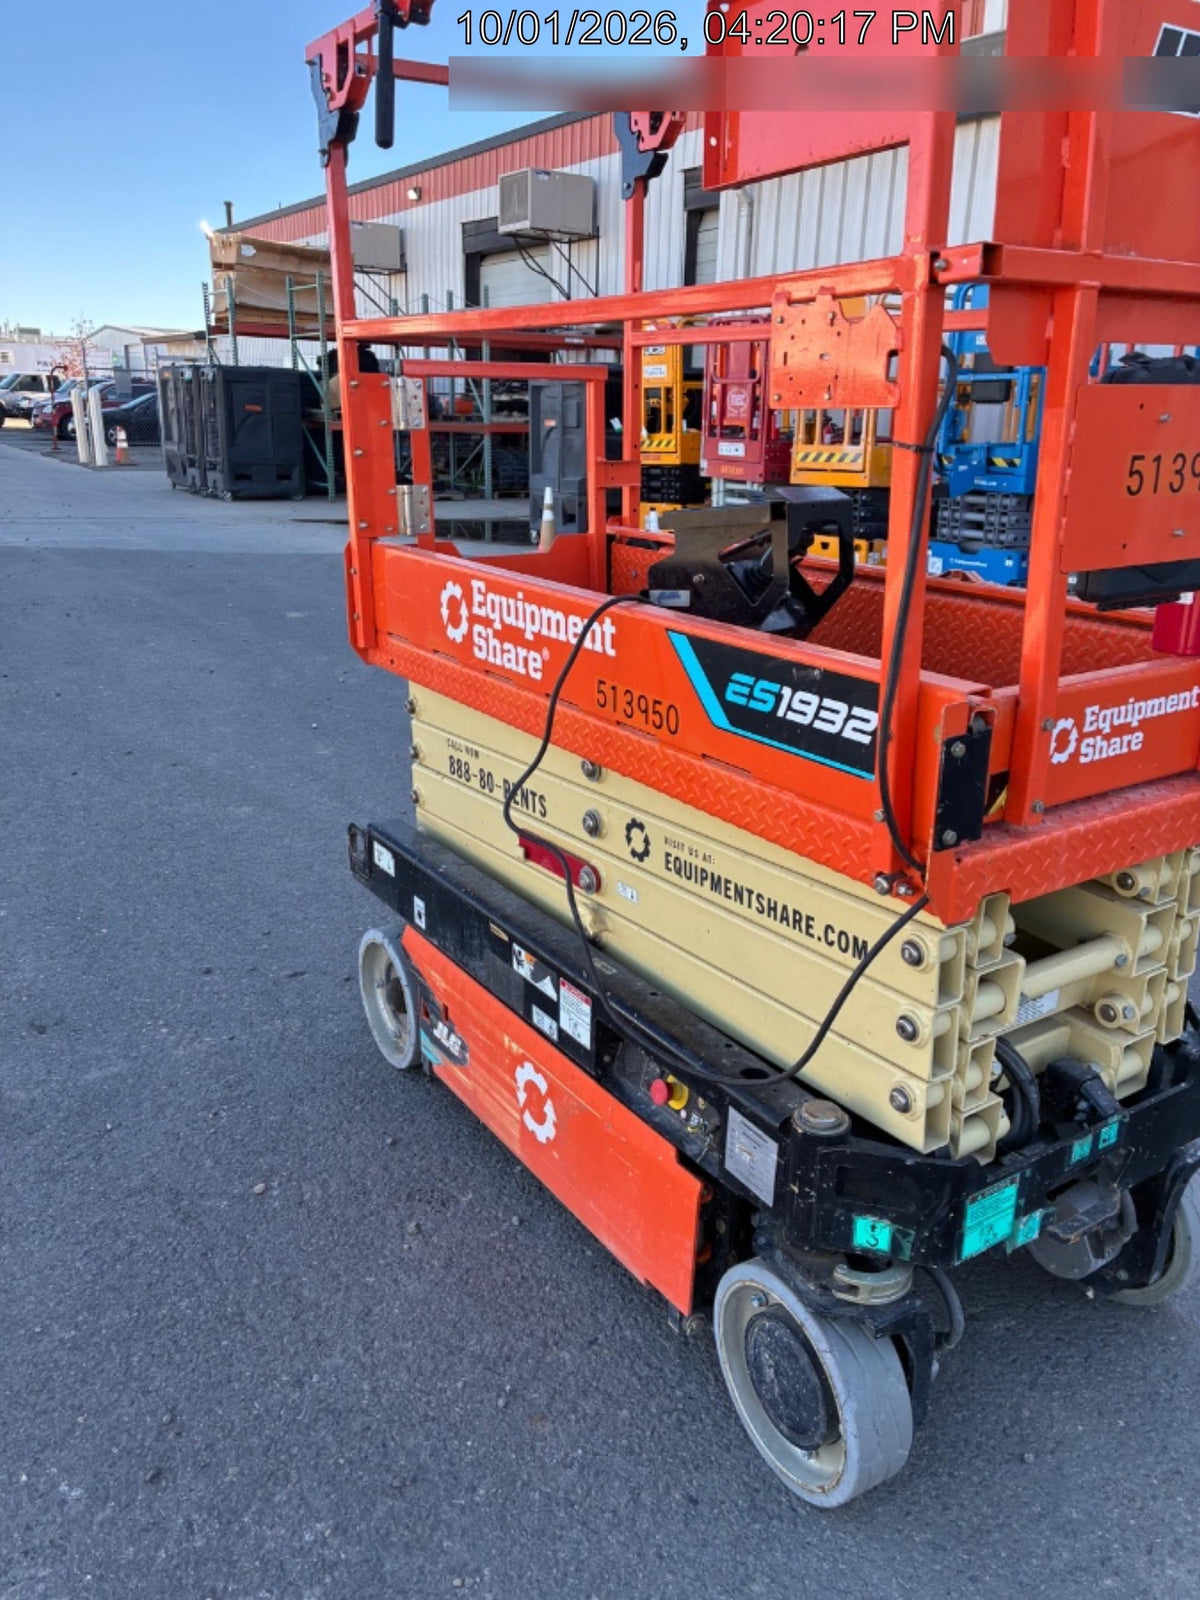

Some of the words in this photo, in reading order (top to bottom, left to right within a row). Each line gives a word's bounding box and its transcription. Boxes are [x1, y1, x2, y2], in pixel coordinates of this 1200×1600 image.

[471, 579, 616, 657] Equipment
[596, 679, 680, 736] 513950
[725, 671, 879, 744] ES1932
[1083, 685, 1200, 735] Equipment
[1079, 731, 1144, 764] Share
[664, 852, 869, 961] EQUIPMENTSHARE.COM
